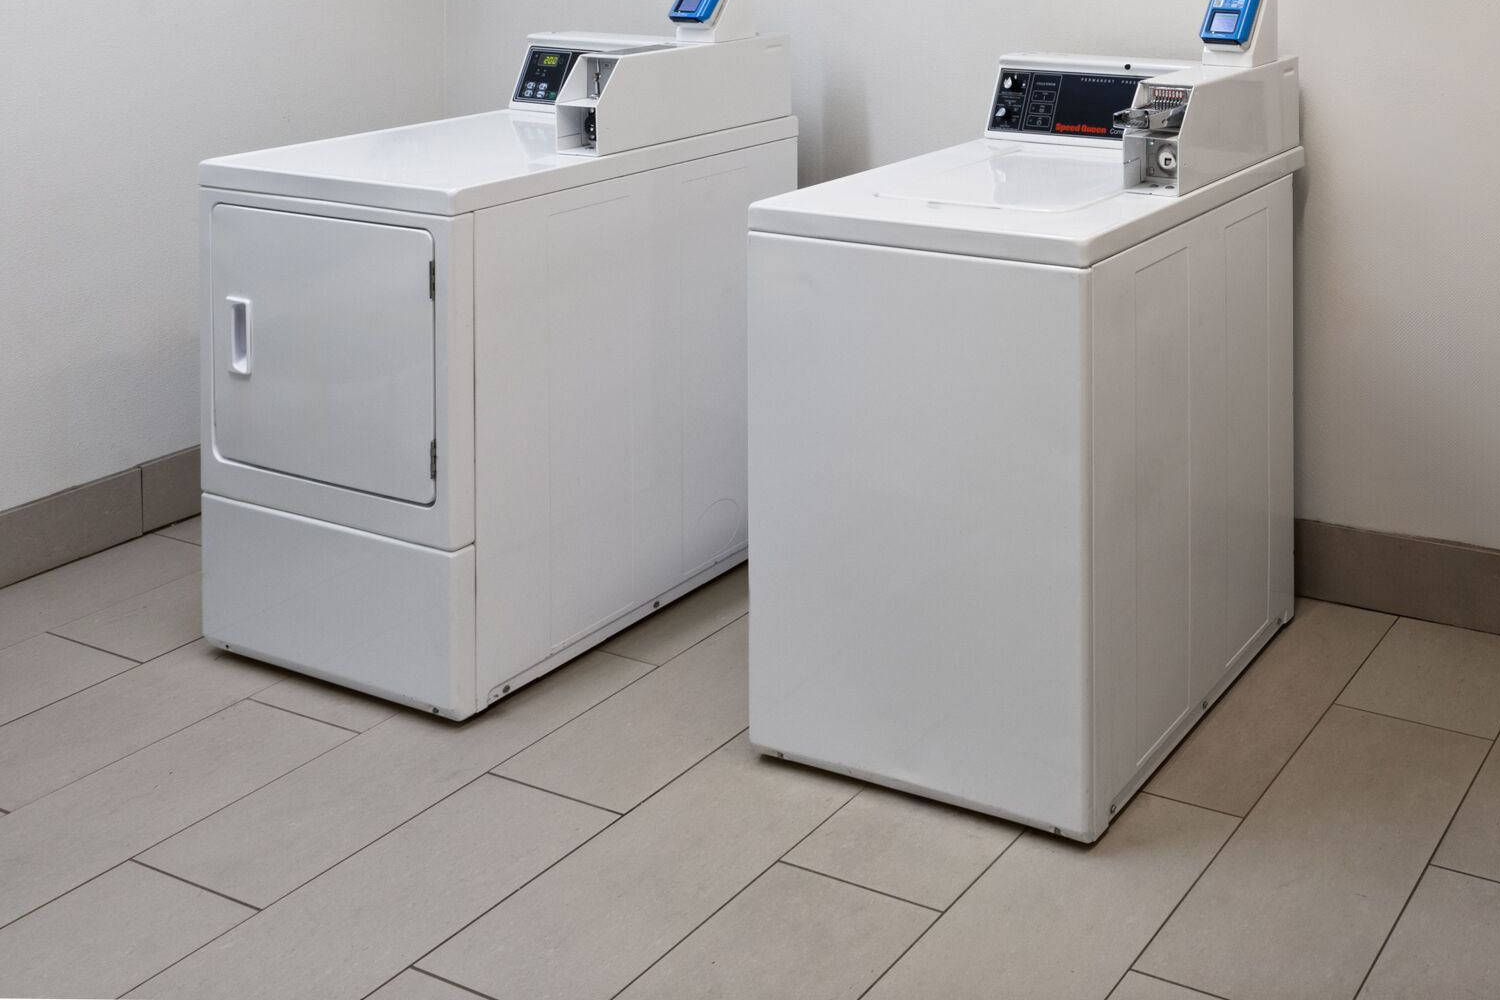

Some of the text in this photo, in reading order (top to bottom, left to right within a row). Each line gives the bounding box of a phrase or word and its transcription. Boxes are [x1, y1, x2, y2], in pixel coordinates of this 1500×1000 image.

[543, 56, 558, 65] 200
[1055, 123, 1081, 132] Speed
[1081, 124, 1106, 134] Queen
